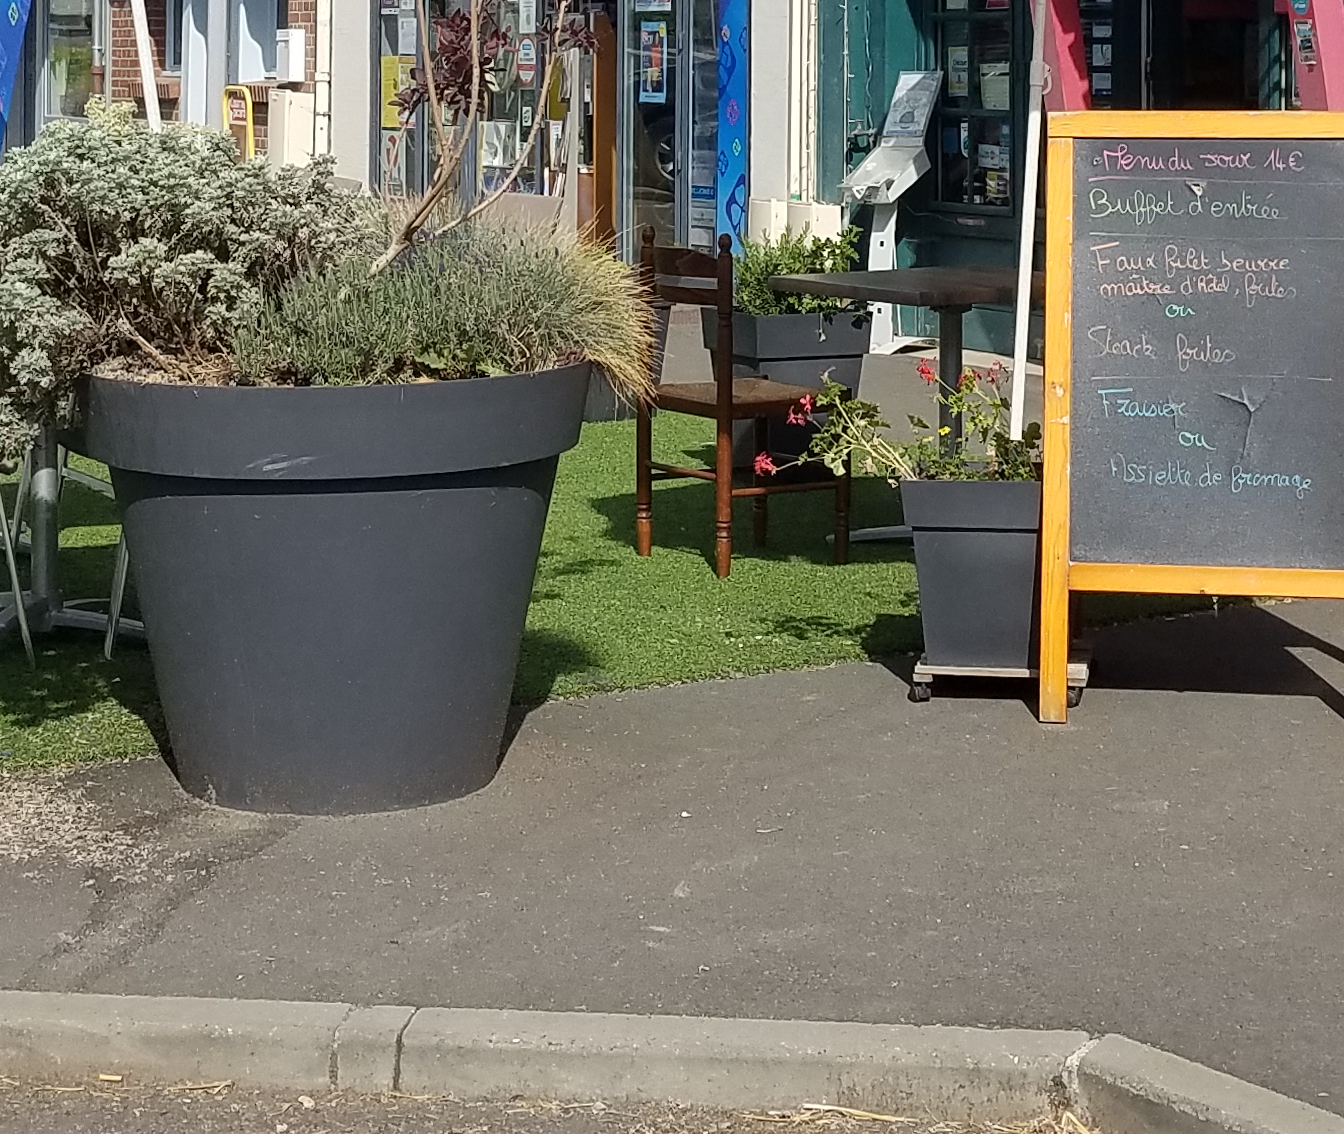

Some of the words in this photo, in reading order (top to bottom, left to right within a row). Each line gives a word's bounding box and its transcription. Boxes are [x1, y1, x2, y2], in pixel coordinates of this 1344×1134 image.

[1103, 144, 1165, 171] Menu
[1168, 147, 1194, 171] du
[1263, 148, 1305, 172] 14€
[1088, 188, 1183, 225] Buffet
[1090, 242, 1157, 274] Faux
[1165, 244, 1209, 278] filet
[1217, 250, 1290, 272] beurre
[1245, 272, 1297, 308] frites
[1165, 303, 1196, 317] ou
[1087, 325, 1156, 359] Steack
[1177, 332, 1236, 372] frites
[1098, 387, 1187, 418] Fraisier
[1178, 431, 1217, 450] ou
[1110, 452, 1193, 487] Assiette
[1199, 463, 1223, 488] de
[1230, 465, 1313, 500] fromage
